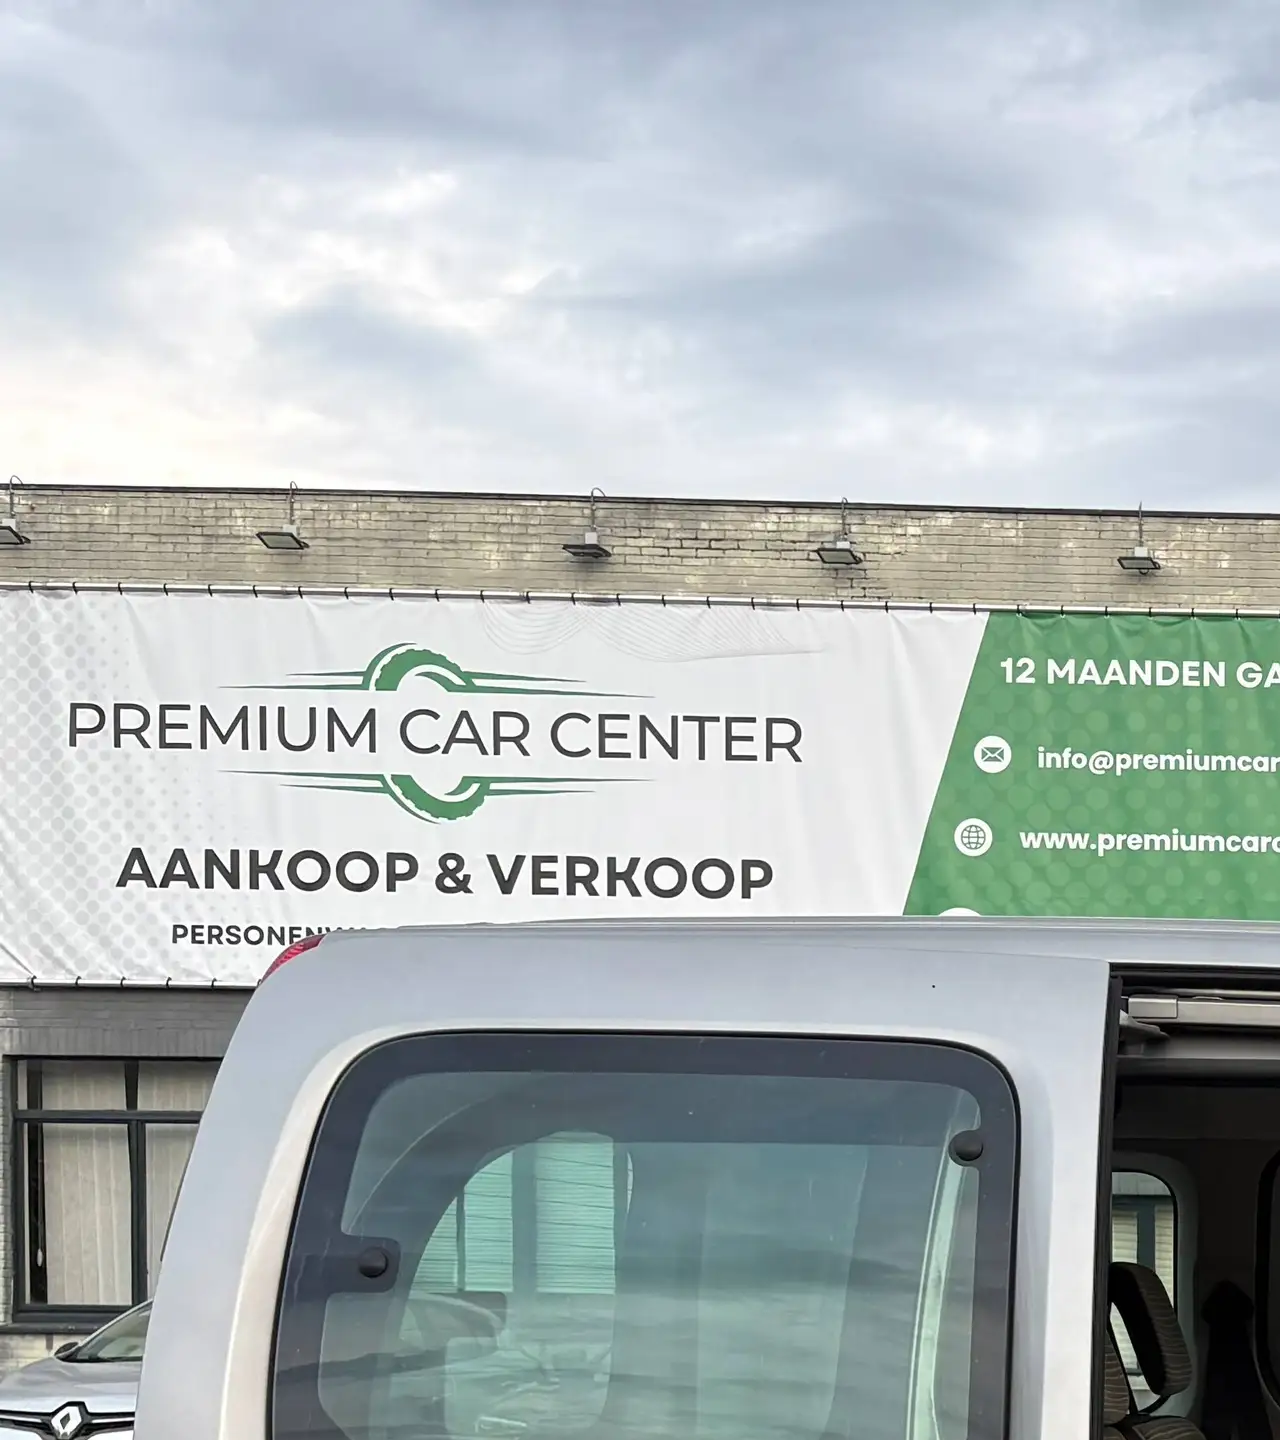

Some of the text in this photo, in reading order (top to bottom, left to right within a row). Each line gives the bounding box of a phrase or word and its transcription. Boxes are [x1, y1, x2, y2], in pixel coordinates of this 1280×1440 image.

[1000, 658, 1036, 684] 12
[1047, 658, 1225, 689] MAANDEN
[70, 703, 803, 762] PREMIUM CAR CENTER
[116, 847, 773, 900] AANKOOP & VERKOOP
